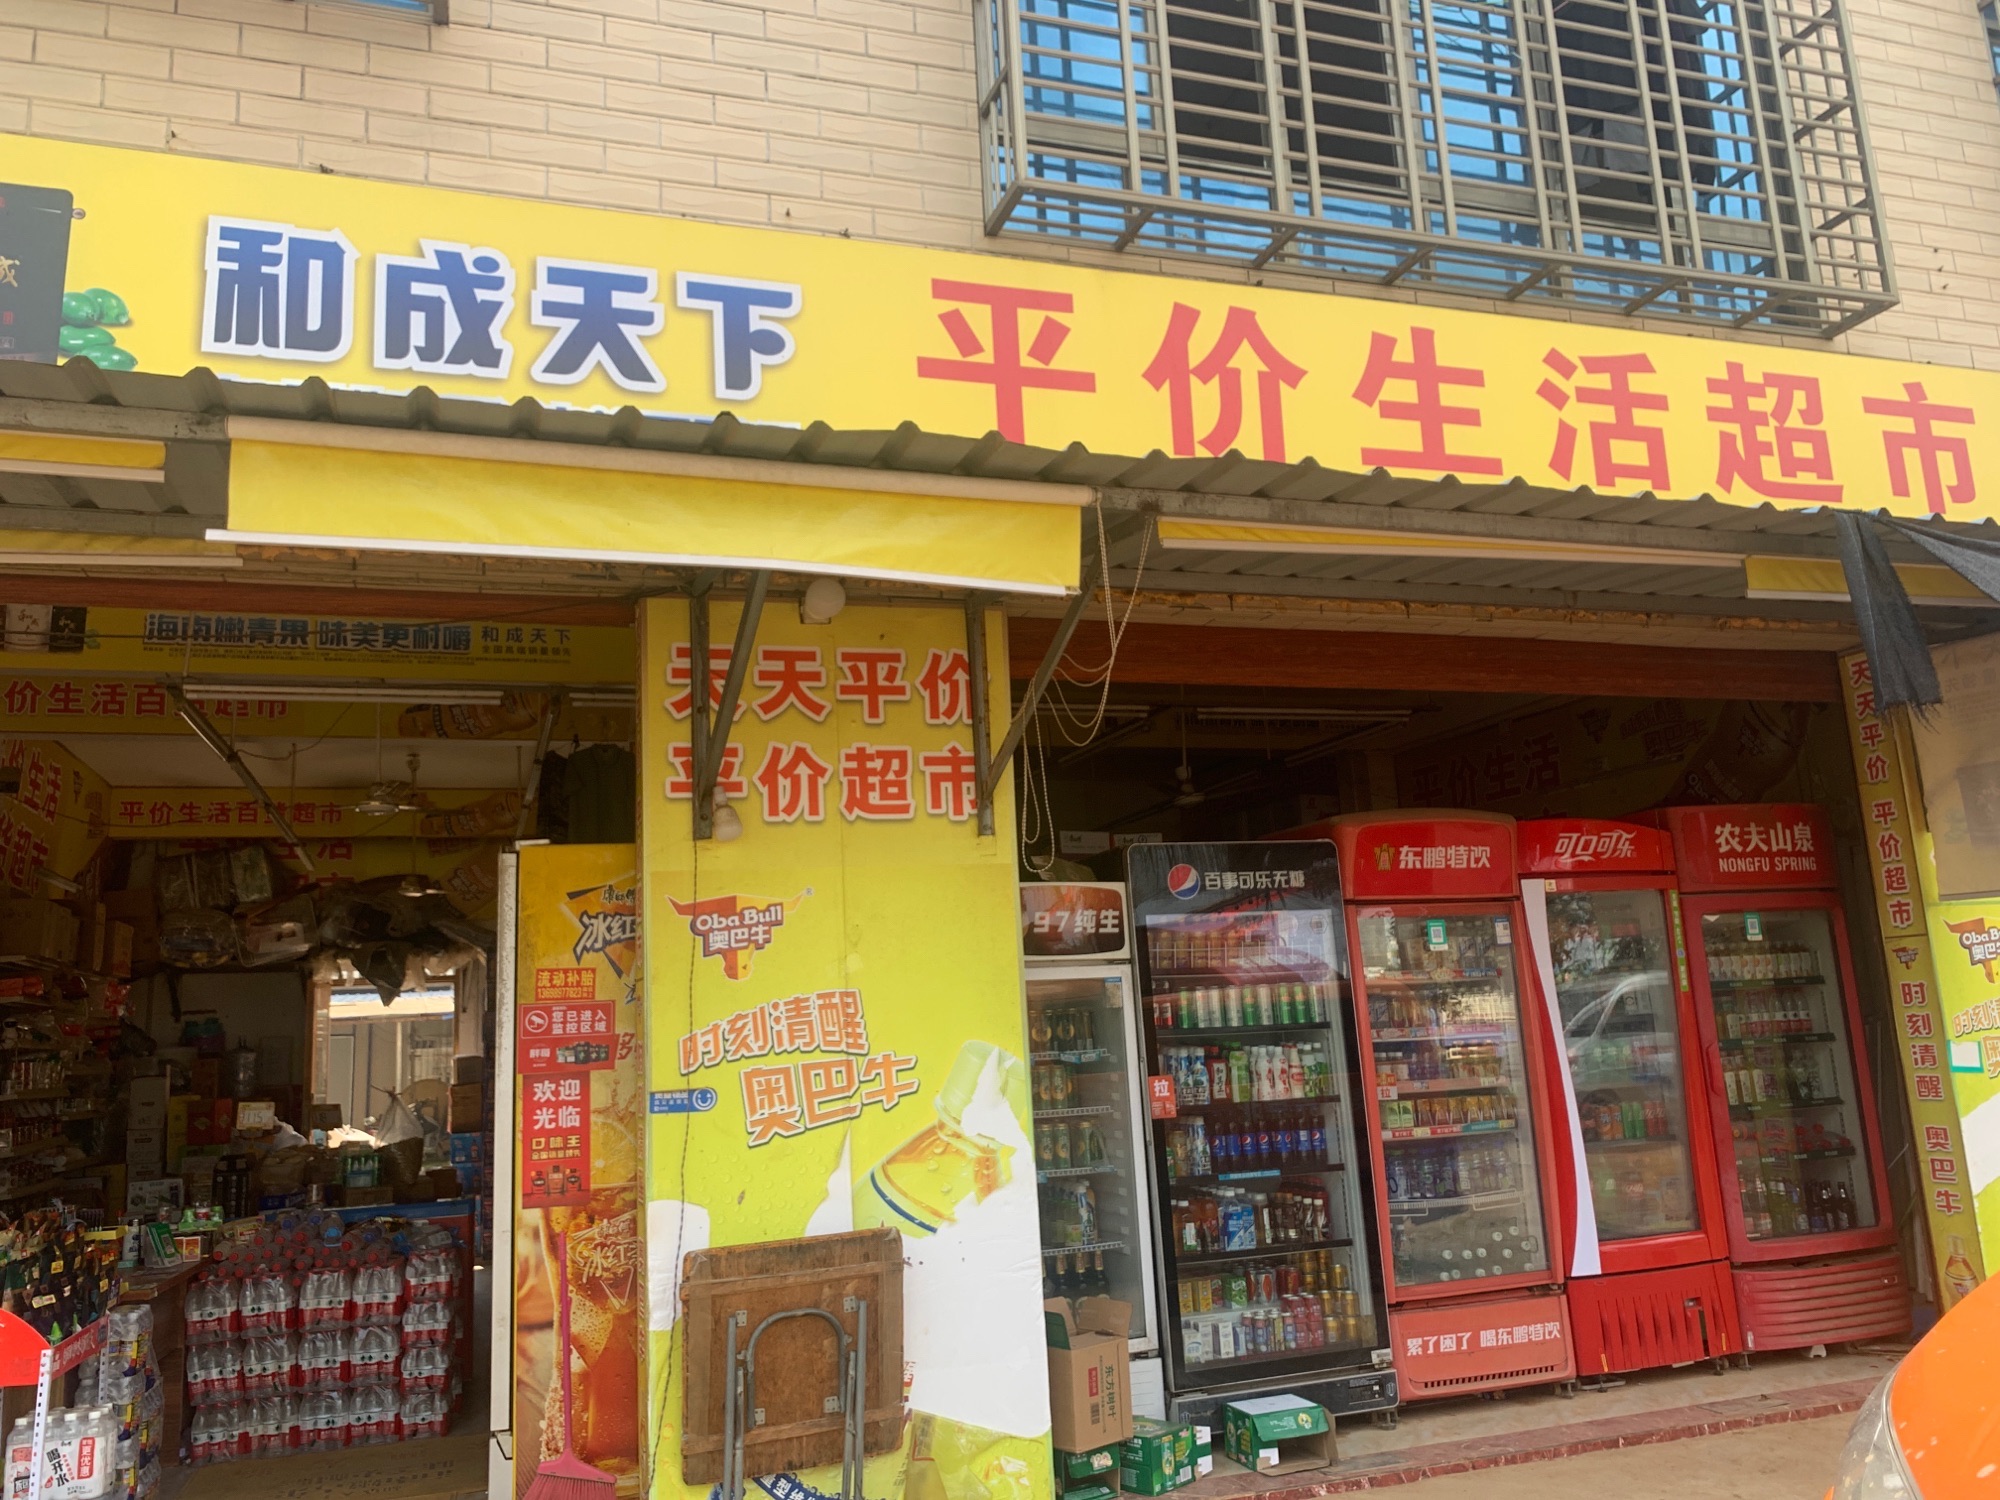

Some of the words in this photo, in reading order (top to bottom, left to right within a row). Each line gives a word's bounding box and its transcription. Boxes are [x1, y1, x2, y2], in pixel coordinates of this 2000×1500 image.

[202, 217, 800, 400] 和成天下
[917, 278, 1976, 514] 平价生活超市
[481, 626, 572, 645] 和成天下
[665, 643, 982, 724] 天天平价
[1850, 659, 1889, 784] 天天平价
[665, 741, 983, 822] 平价超市
[1555, 830, 1636, 861] 可口可乐
[1715, 822, 1814, 854] 农夫山泉
[1398, 845, 1491, 870] 东鹏特饮
[1719, 857, 1769, 873] NONGFU
[1774, 856, 1816, 872] SPRING
[1872, 800, 1912, 929] 平价超市
[1204, 870, 1305, 891] 百事可乐无糖
[696, 909, 741, 931] Oba
[743, 904, 783, 926] Bull
[709, 924, 770, 950] 奥巴牛
[1962, 932, 1989, 945] Oba
[537, 970, 594, 987] 流动补胎
[552, 1010, 607, 1022] 您已进入
[552, 1021, 607, 1034] 监控区域
[679, 988, 868, 1075] 时刻清醒
[1900, 981, 1944, 1100] 时刻清醒
[533, 1079, 581, 1103] 欢迎
[740, 1052, 918, 1147] 奥巴牛
[1154, 1079, 1170, 1097] 拉
[533, 1106, 581, 1130] 光临
[532, 1135, 581, 1150] 口味王
[1925, 1125, 1962, 1215] 奥巴牛
[1406, 1331, 1473, 1357] 累了困了
[1480, 1321, 1561, 1349] 喝东鹏特饮
[1105, 1364, 1116, 1418] 东方树叶
[46, 1448, 70, 1487] 喝开水
[80, 1446, 91, 1477] 更优惠
